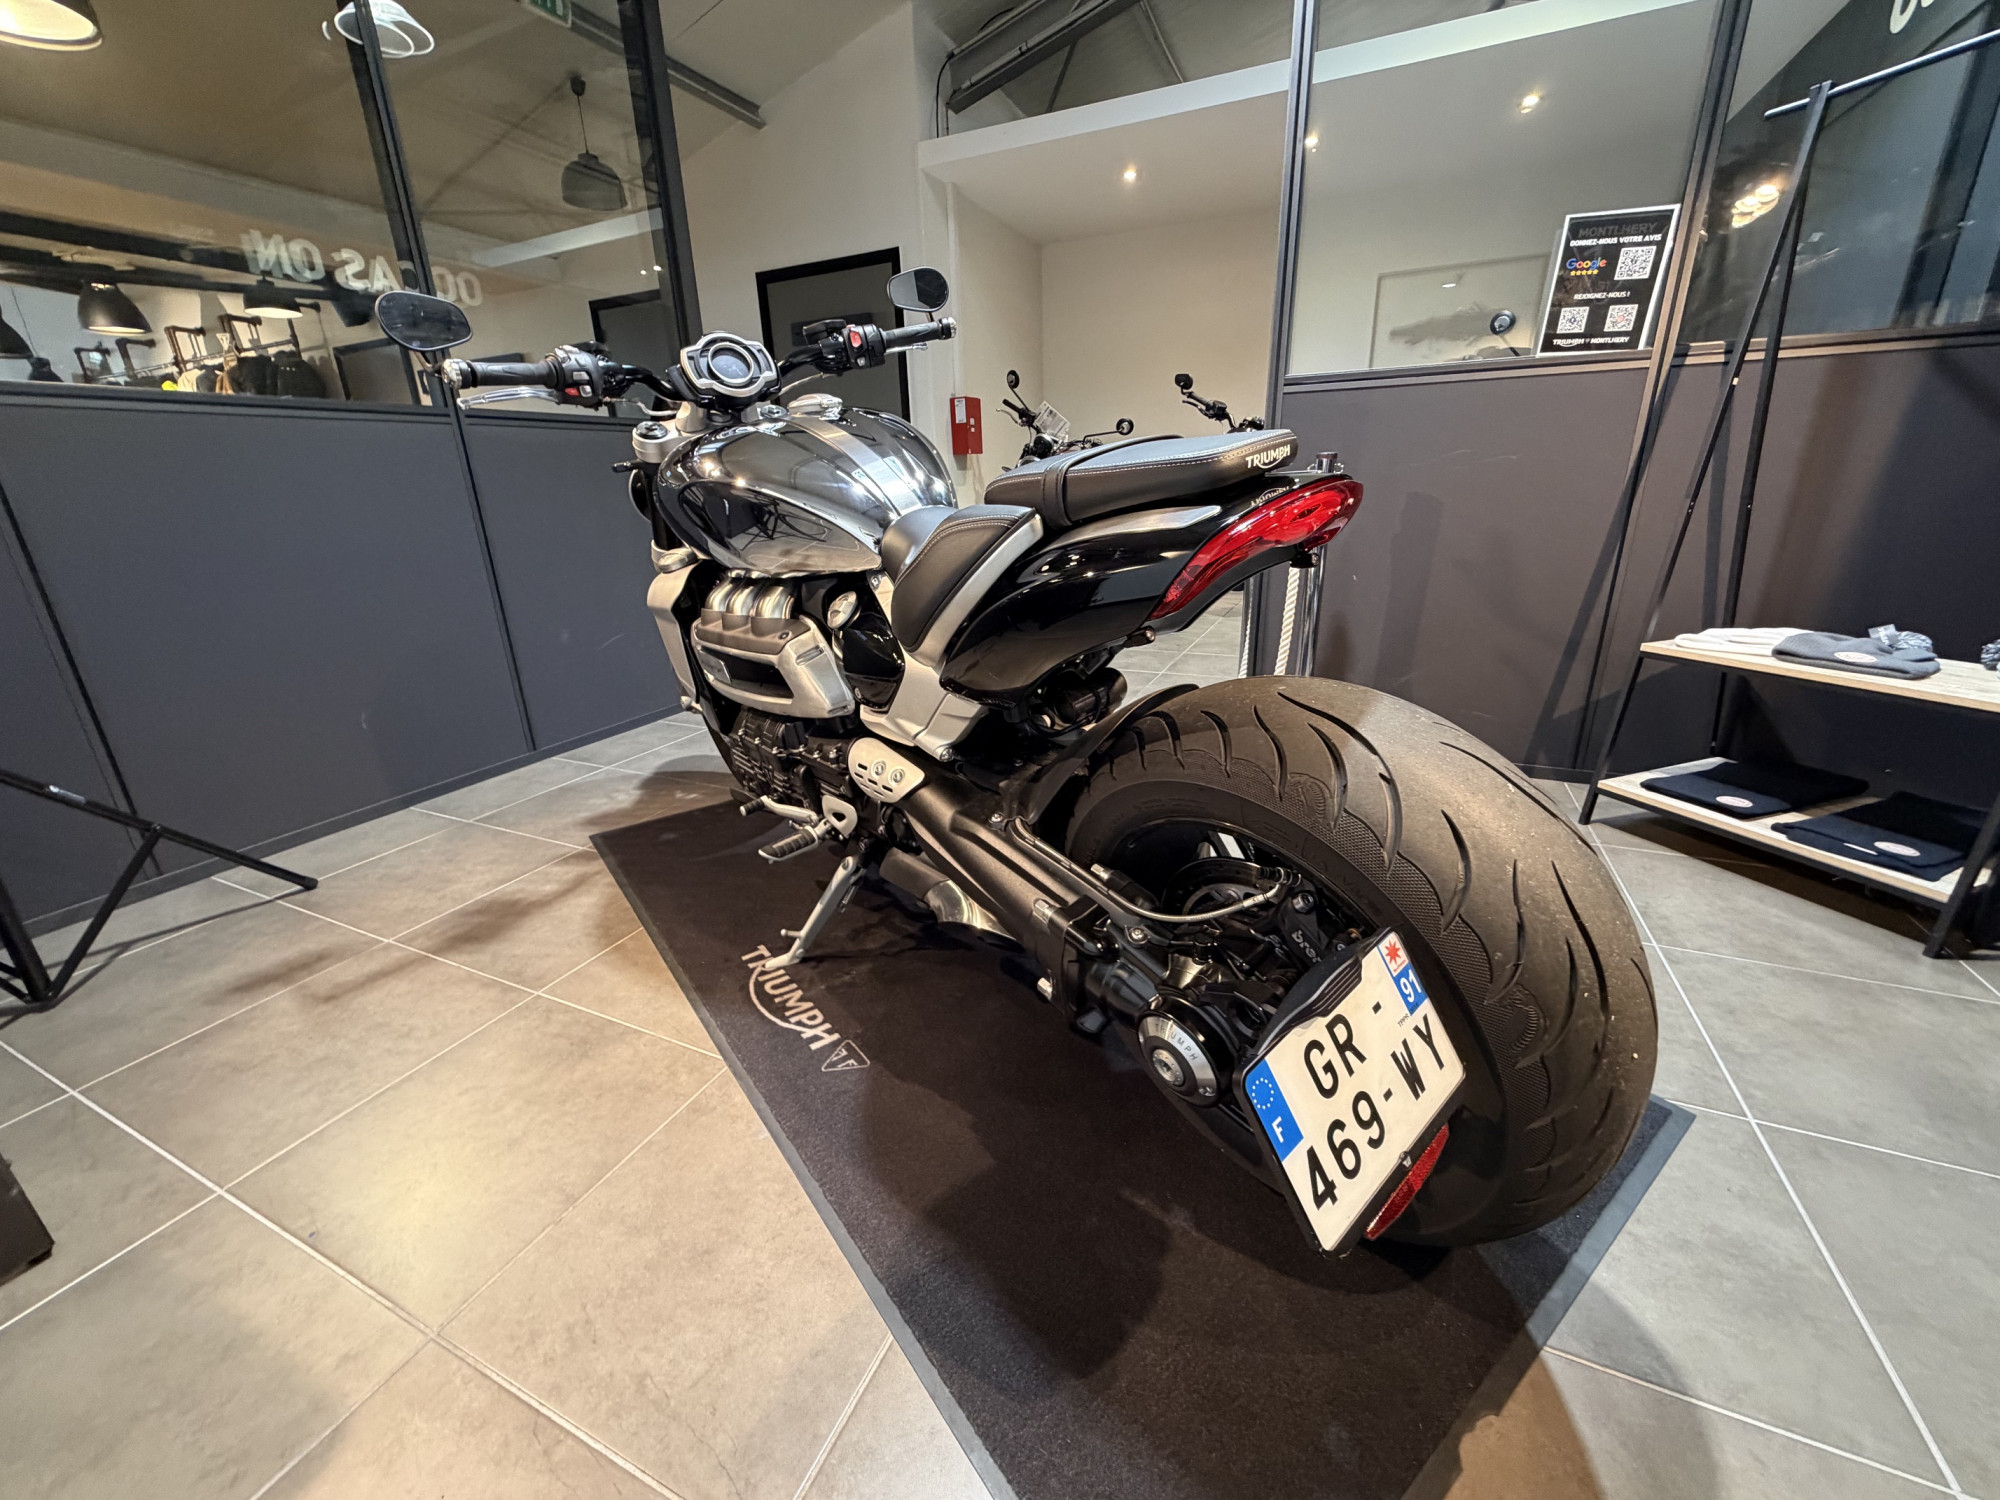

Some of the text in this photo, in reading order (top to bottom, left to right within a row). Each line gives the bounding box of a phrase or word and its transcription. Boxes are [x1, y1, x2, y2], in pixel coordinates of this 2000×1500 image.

[1619, 235, 1643, 243] VOTRE
[1643, 234, 1662, 242] AVIS
[1566, 257, 1607, 270] Google
[1552, 336, 1630, 347] TRIUMPH MONTLHERY
[1245, 444, 1291, 469] TRIUMPH
[741, 944, 842, 1050] TRIUMPH
[1400, 969, 1422, 1003] 91
[1154, 1022, 1198, 1061] TRUMPH
[1271, 1116, 1285, 1143] F
